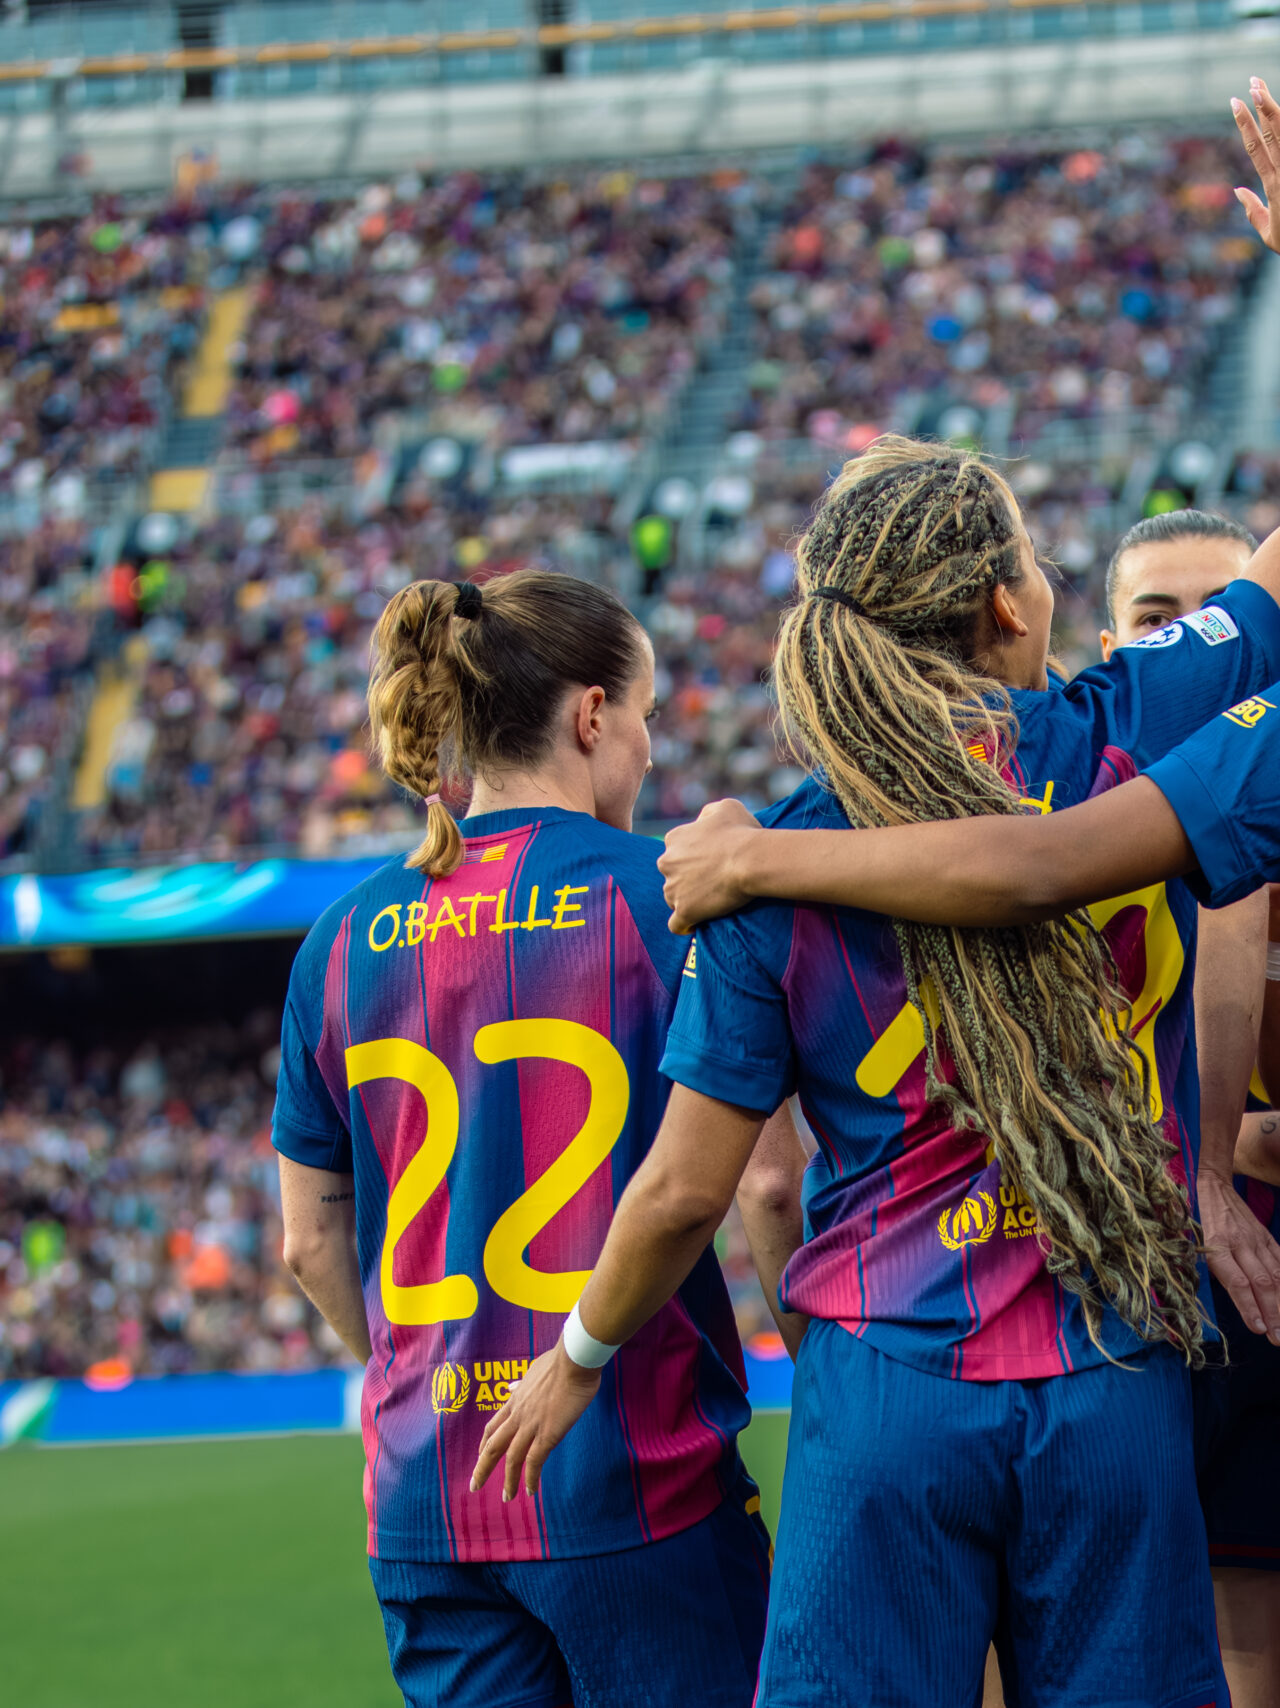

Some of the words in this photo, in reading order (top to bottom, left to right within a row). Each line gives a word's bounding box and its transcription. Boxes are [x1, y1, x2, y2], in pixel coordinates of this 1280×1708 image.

[368, 884, 590, 952] O.BATLLE
[344, 1017, 630, 1326] 22
[473, 1359, 535, 1381] UNH
